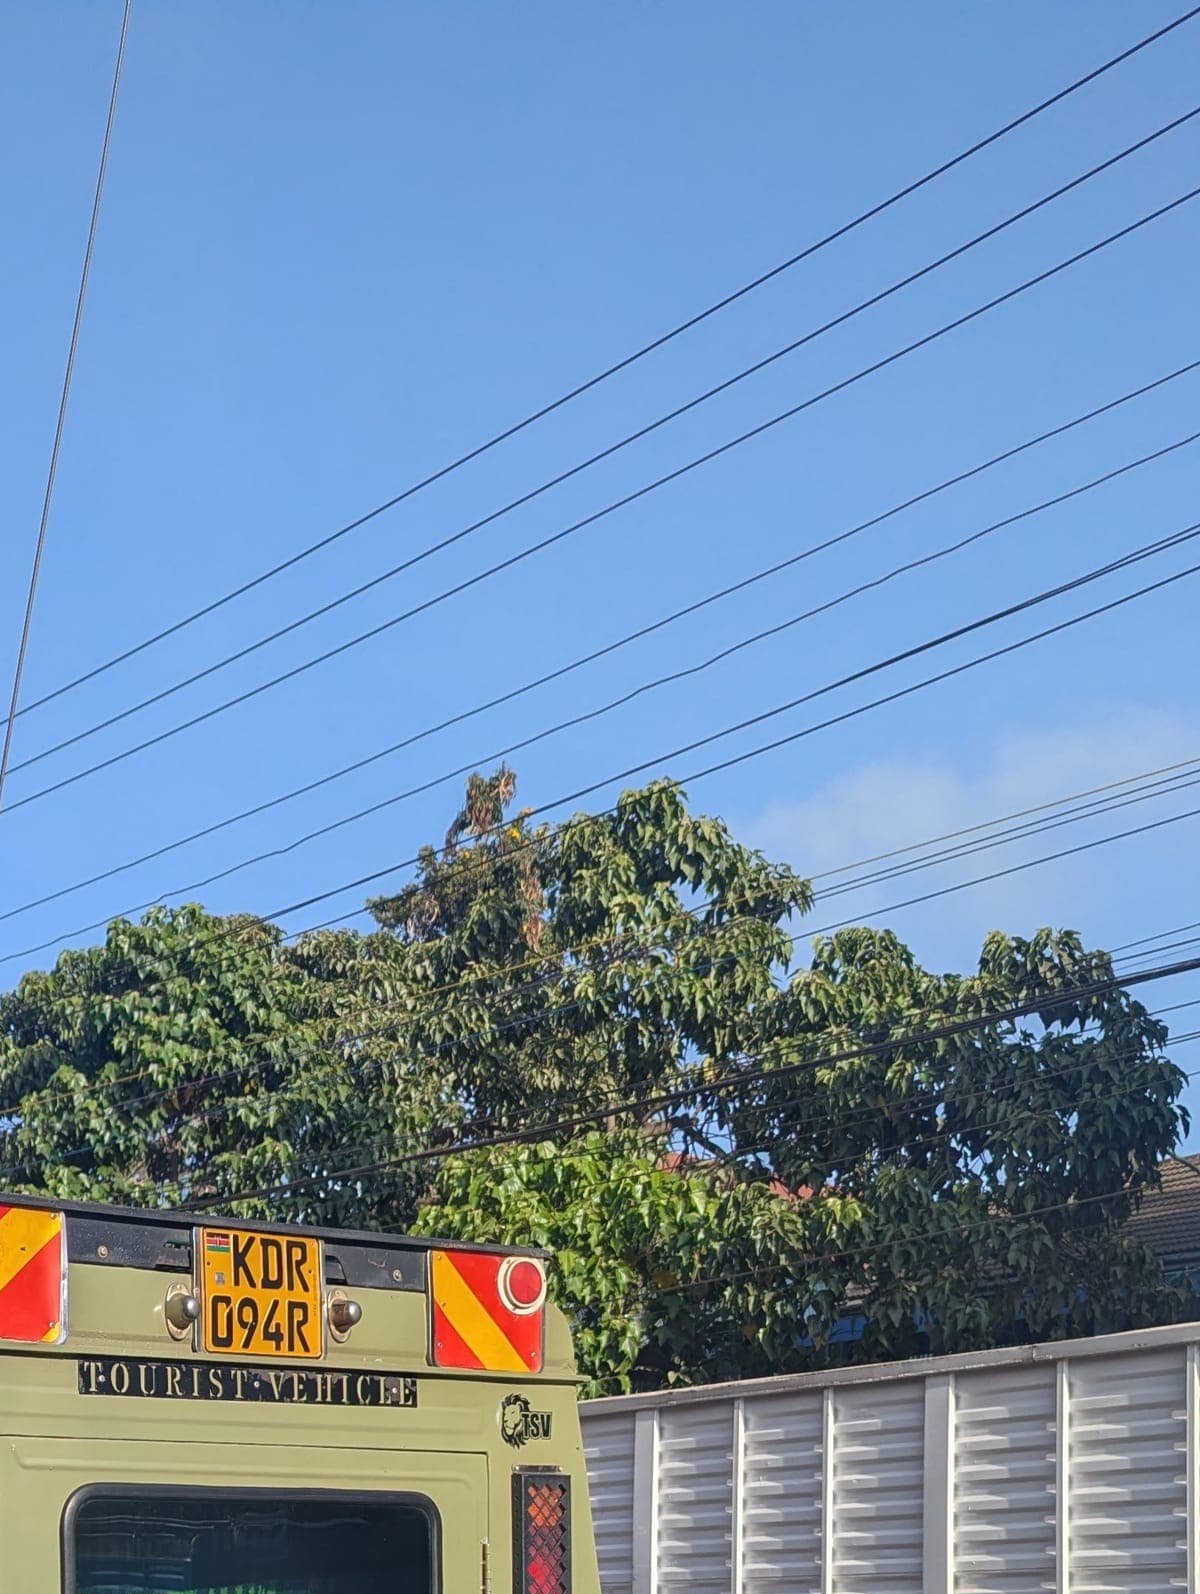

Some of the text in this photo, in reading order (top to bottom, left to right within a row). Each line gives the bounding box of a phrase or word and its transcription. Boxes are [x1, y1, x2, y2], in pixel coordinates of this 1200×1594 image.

[233, 1234, 310, 1293] KDR
[211, 1295, 311, 1353] 094R
[84, 1361, 413, 1405] TOURIST VEHICLE
[521, 1413, 551, 1438] TSV
